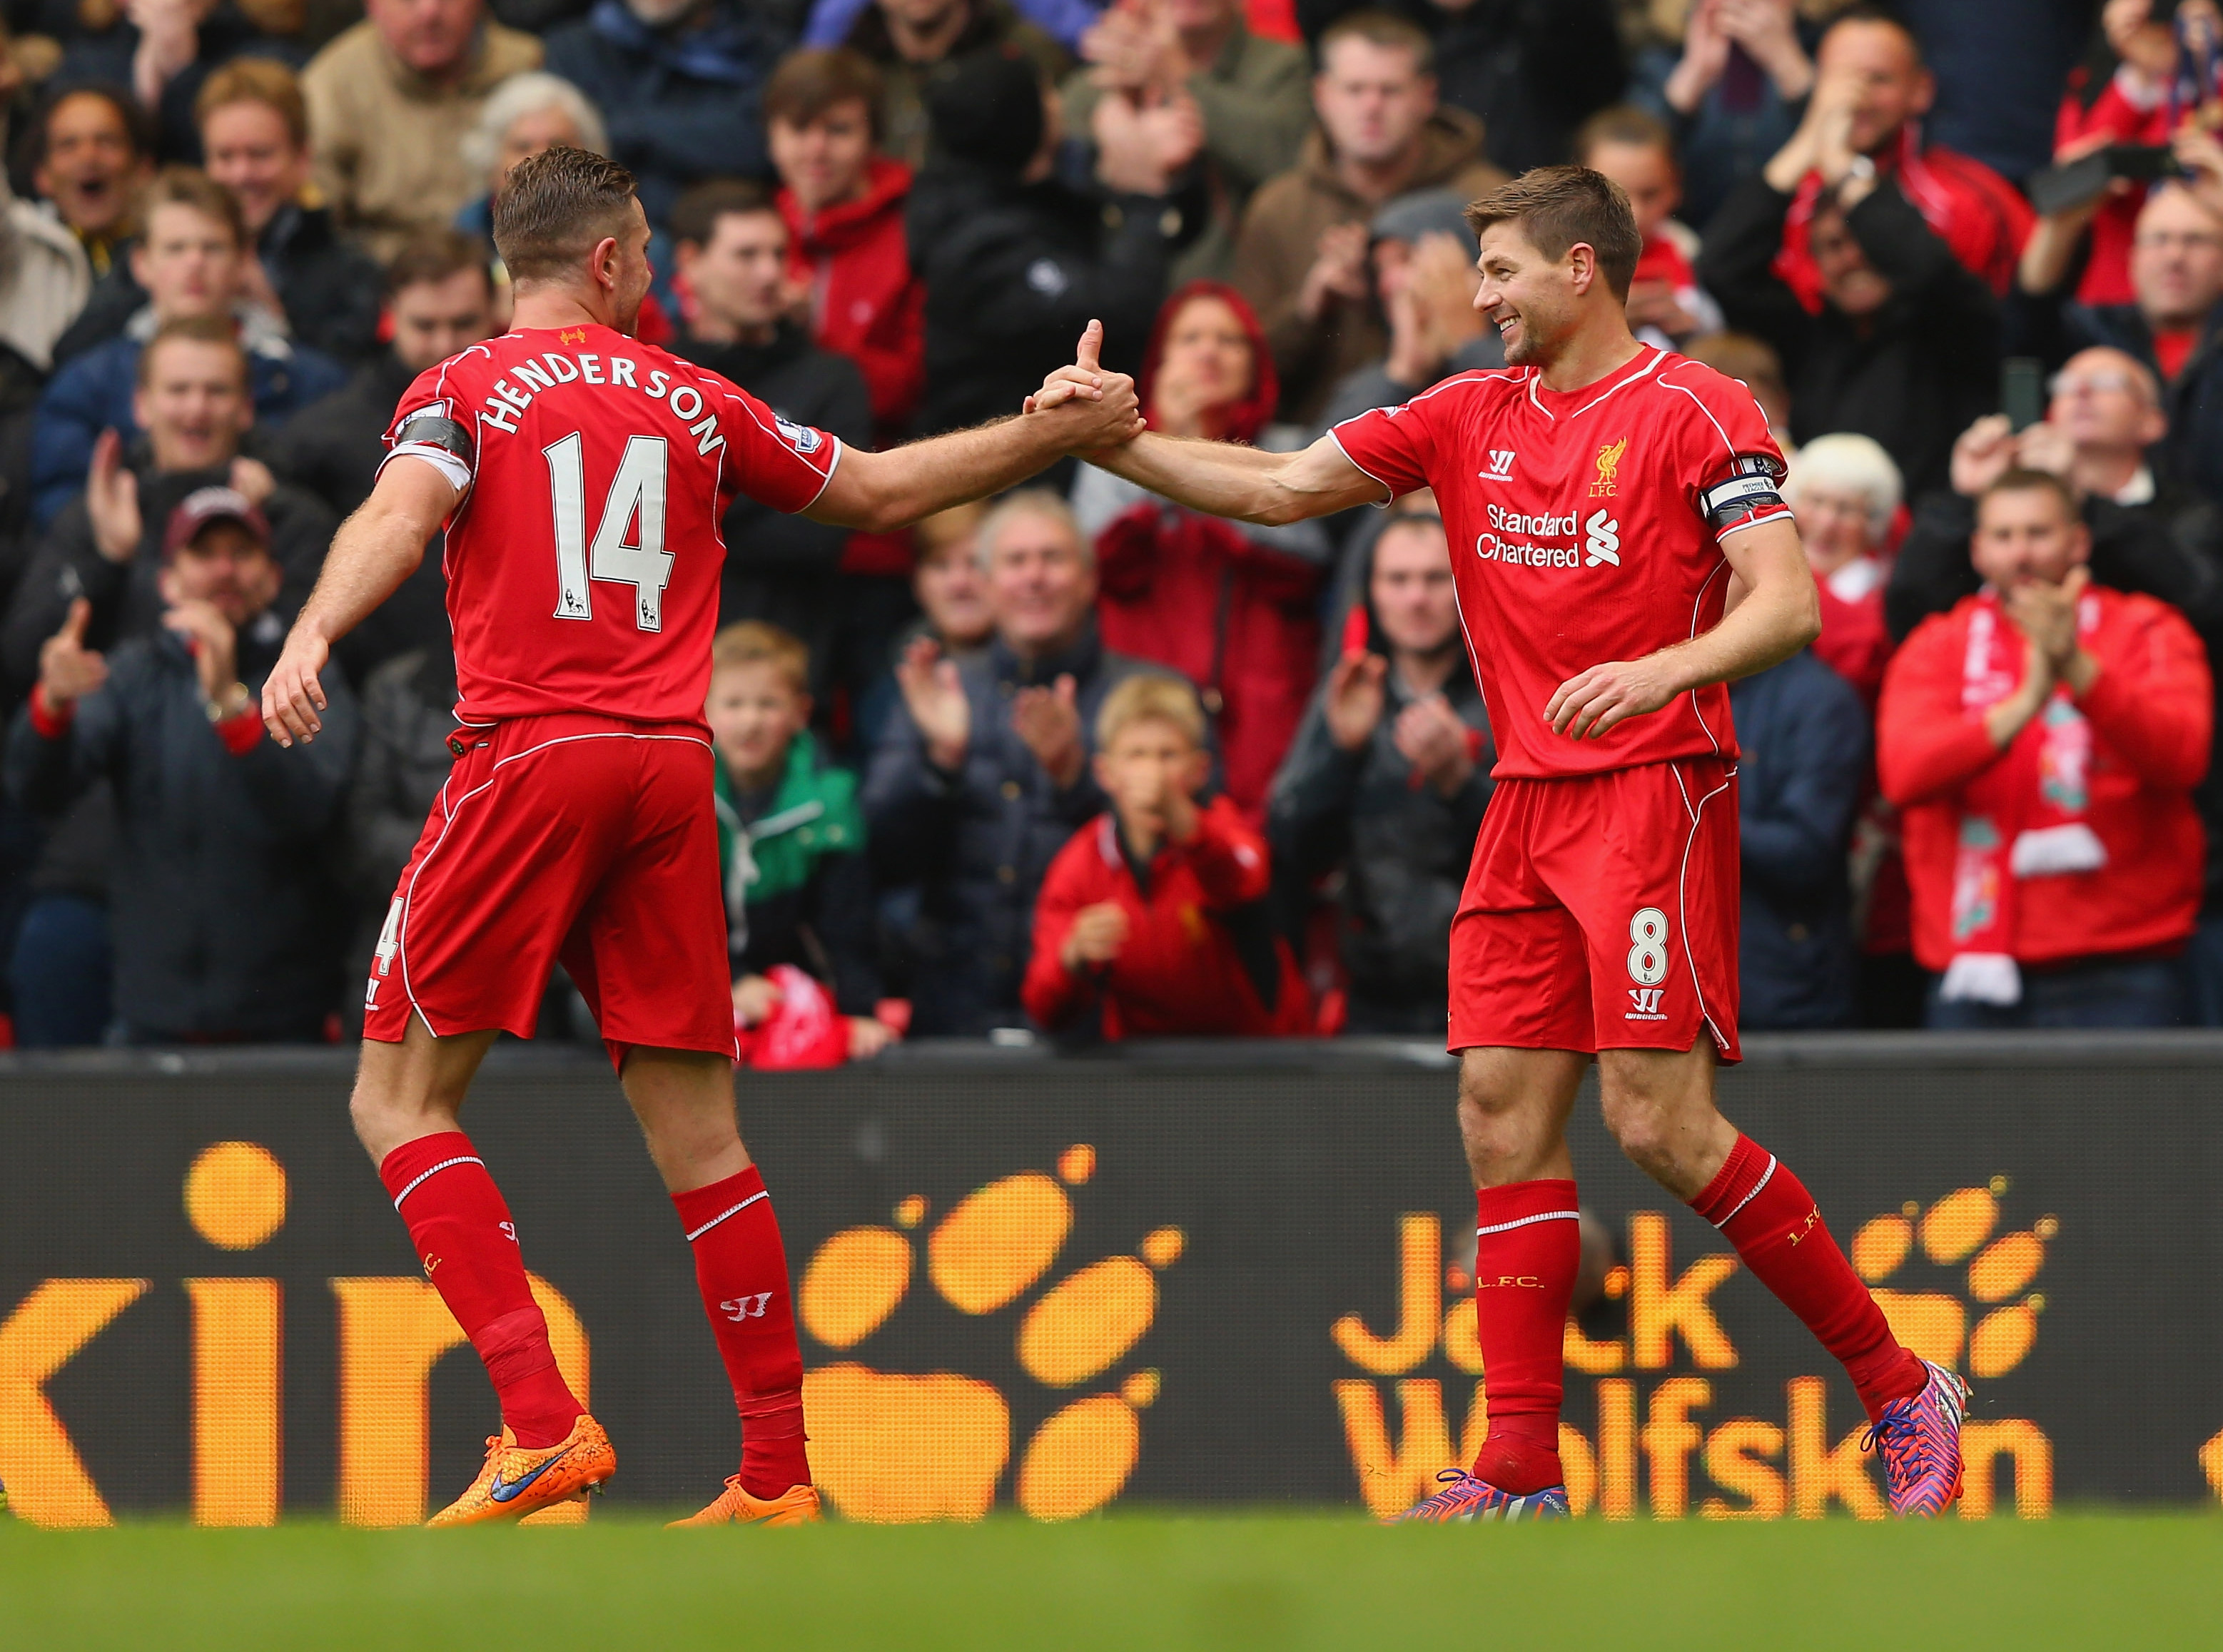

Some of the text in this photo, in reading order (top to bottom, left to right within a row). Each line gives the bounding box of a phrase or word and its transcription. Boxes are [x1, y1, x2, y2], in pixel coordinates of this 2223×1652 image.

[480, 353, 726, 456] HENDERSON
[1588, 485, 1619, 497] L.F.C.
[541, 430, 676, 633] 14
[1487, 503, 1578, 537] Standard
[1477, 532, 1580, 568] Chartered
[1627, 907, 1668, 985] 8
[1477, 1276, 1545, 1289] L.F.C.
